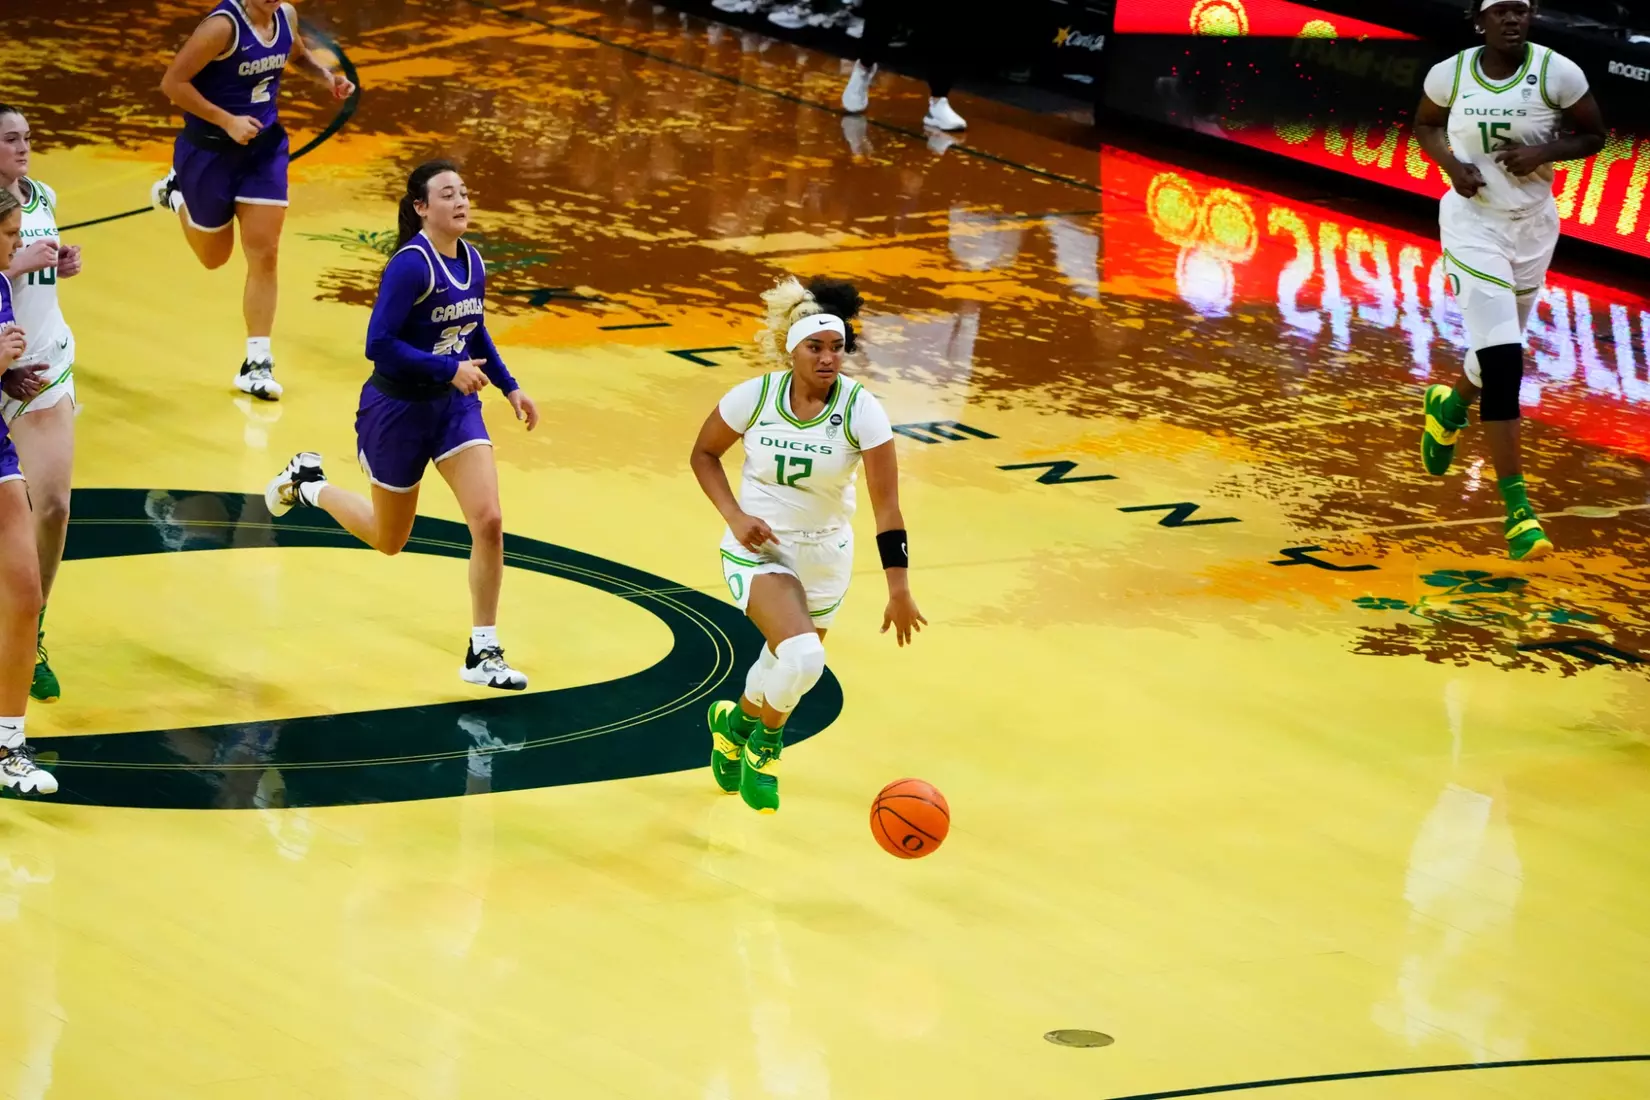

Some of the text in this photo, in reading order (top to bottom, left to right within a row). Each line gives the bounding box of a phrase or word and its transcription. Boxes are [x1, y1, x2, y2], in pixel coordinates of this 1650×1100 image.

[250, 76, 274, 103] 2
[1464, 108, 1527, 117] DUCKS
[1478, 122, 1511, 154] 15
[760, 436, 833, 455] DUCKS
[774, 454, 813, 487] 12
